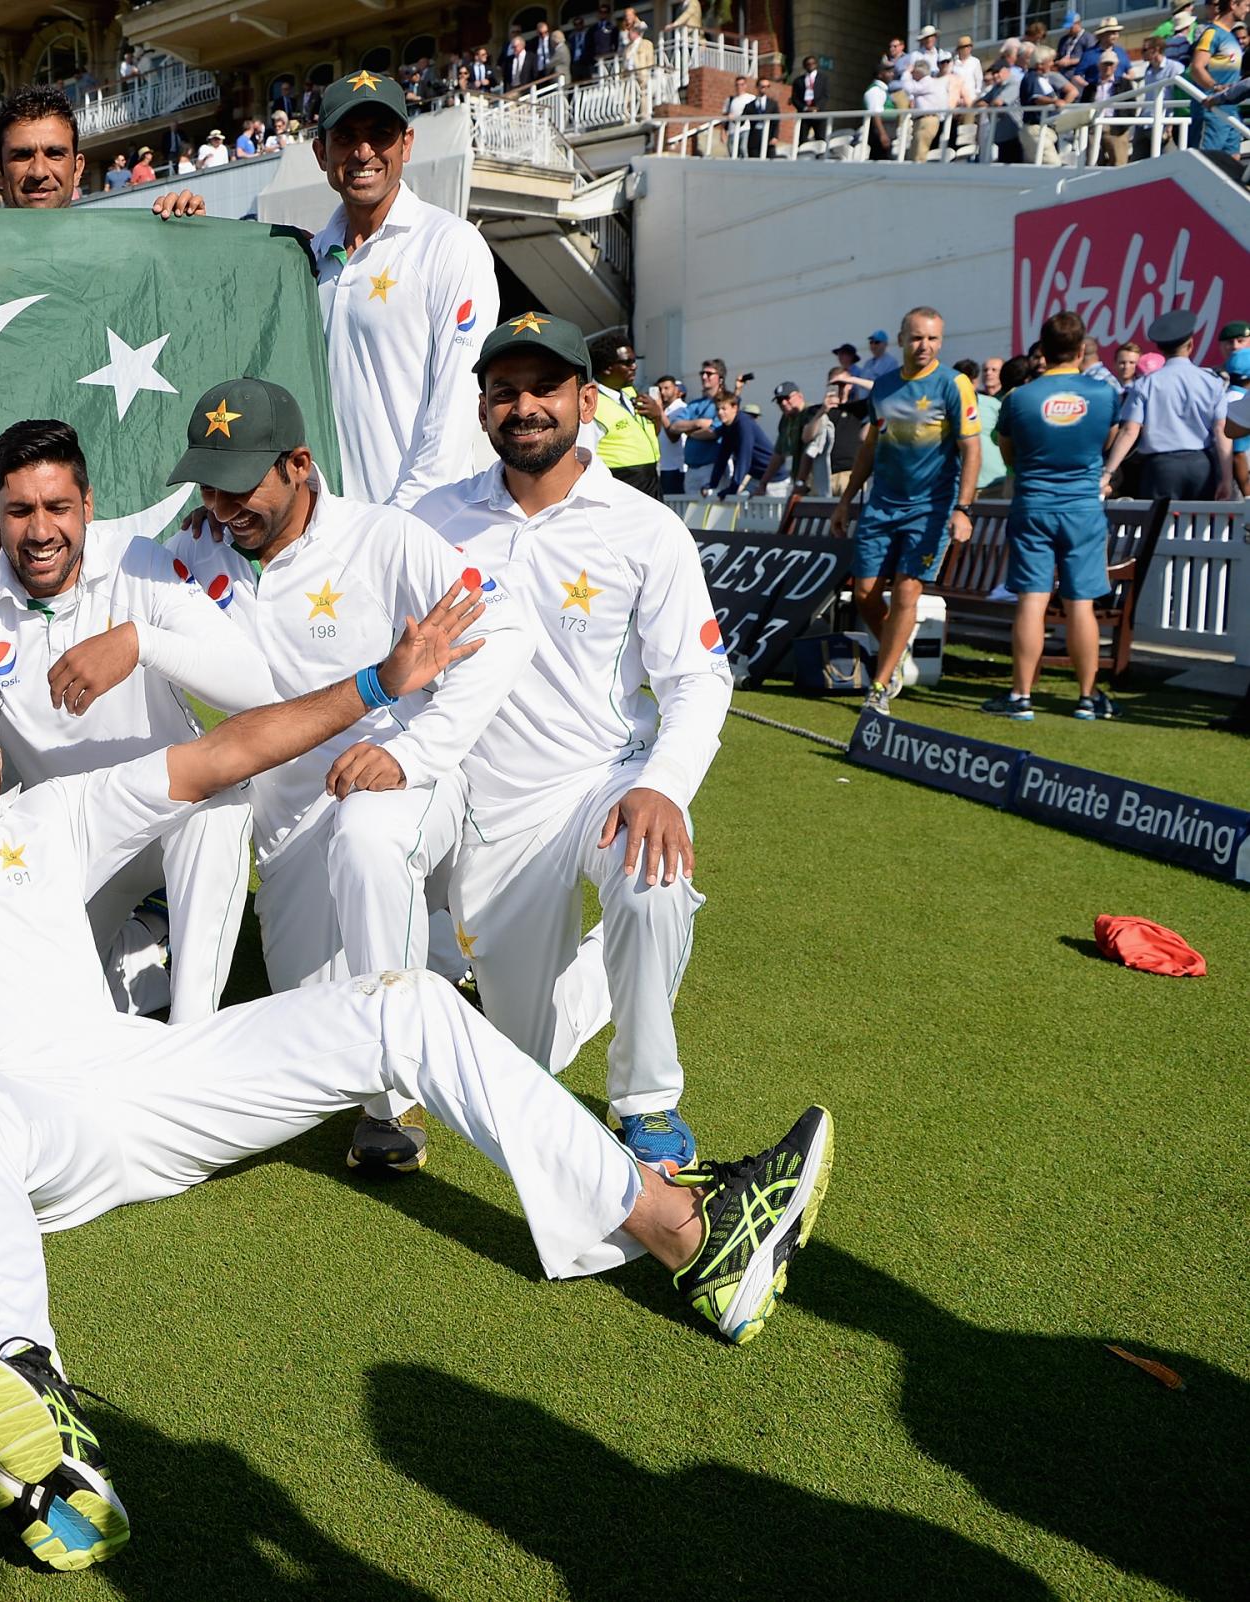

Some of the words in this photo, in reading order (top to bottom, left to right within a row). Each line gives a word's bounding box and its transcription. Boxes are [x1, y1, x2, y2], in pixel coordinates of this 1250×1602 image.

[1020, 223, 1223, 367] Vitality
[712, 545, 838, 601] ESTD
[309, 625, 337, 639] 198
[560, 616, 587, 633] 173
[883, 722, 1010, 789] Investec
[1021, 766, 1110, 820] Private
[1116, 791, 1236, 865] Banking
